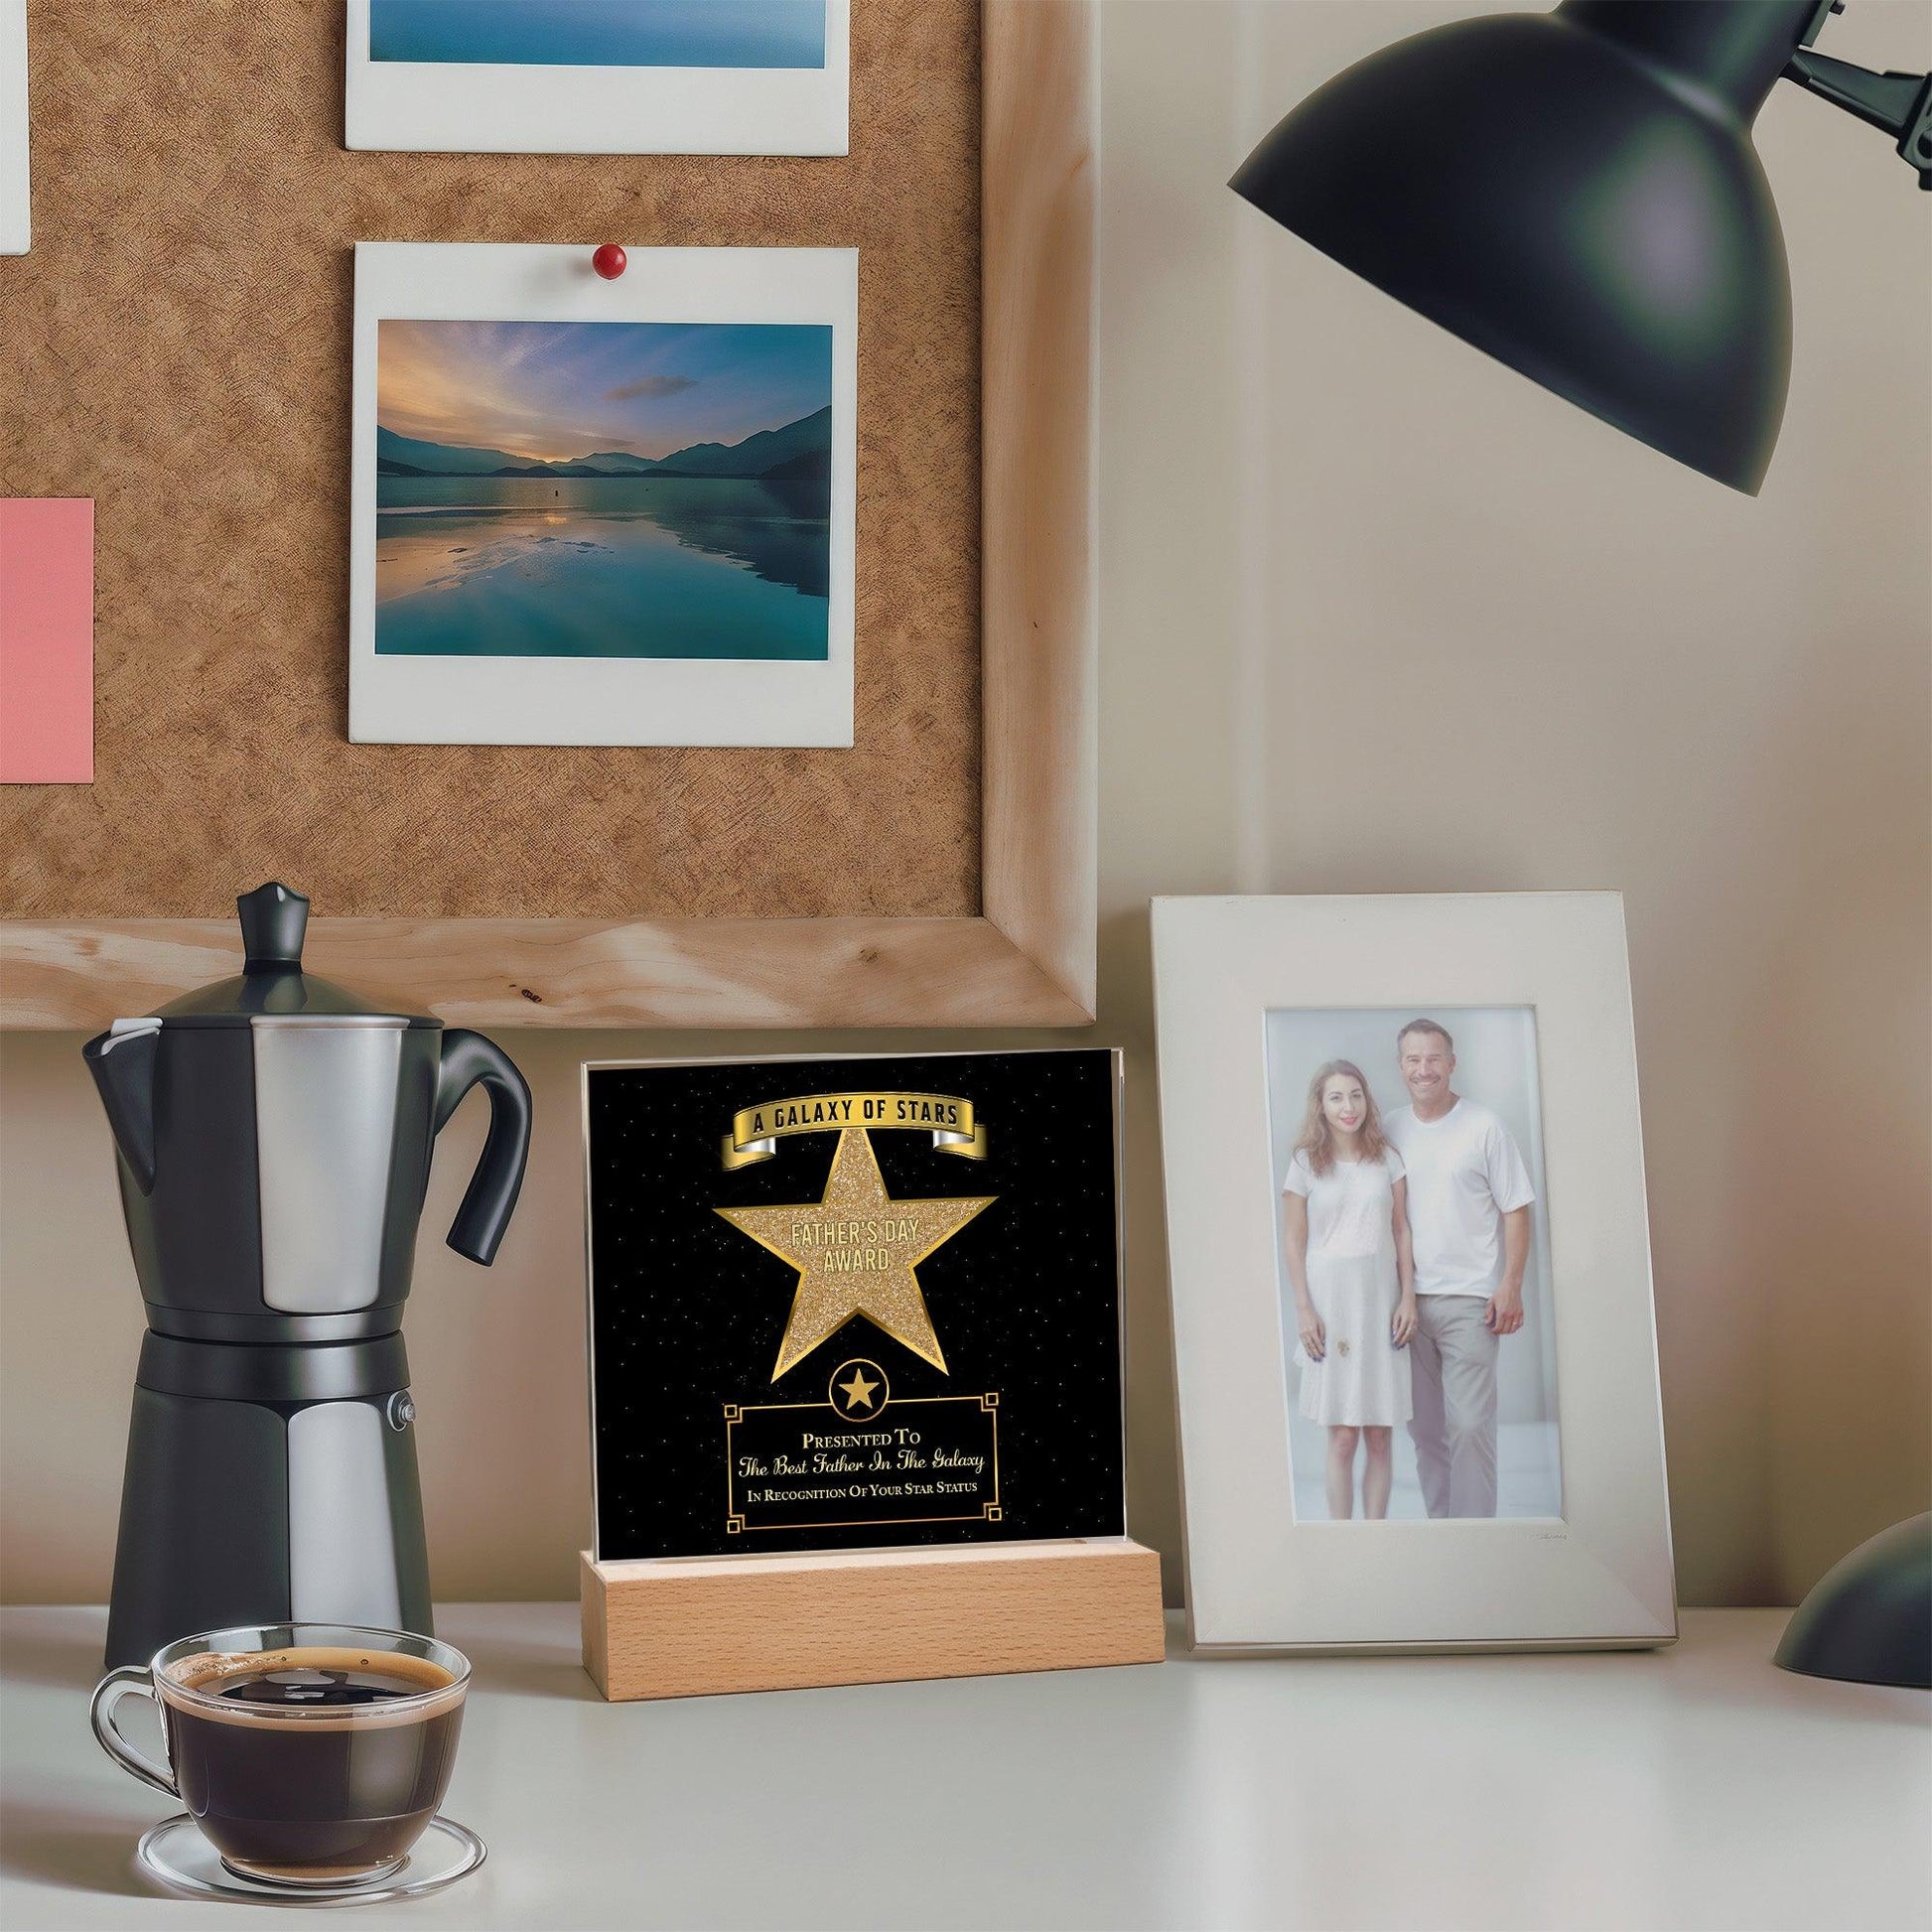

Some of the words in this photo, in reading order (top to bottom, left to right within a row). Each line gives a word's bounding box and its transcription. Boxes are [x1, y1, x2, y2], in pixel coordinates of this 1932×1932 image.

[753, 1112, 764, 1134] A
[774, 1099, 852, 1128] GALAXY
[864, 1099, 886, 1120] OF
[897, 1099, 957, 1125] STARS
[791, 1220, 878, 1246] FATHER'S
[885, 1218, 920, 1243] DAY
[823, 1248, 889, 1273] AWARD
[738, 1456, 768, 1477] The
[772, 1454, 808, 1475] Best
[812, 1452, 864, 1474] Father
[869, 1450, 892, 1471] In
[897, 1449, 927, 1470] The
[931, 1448, 986, 1474] Galaxy
